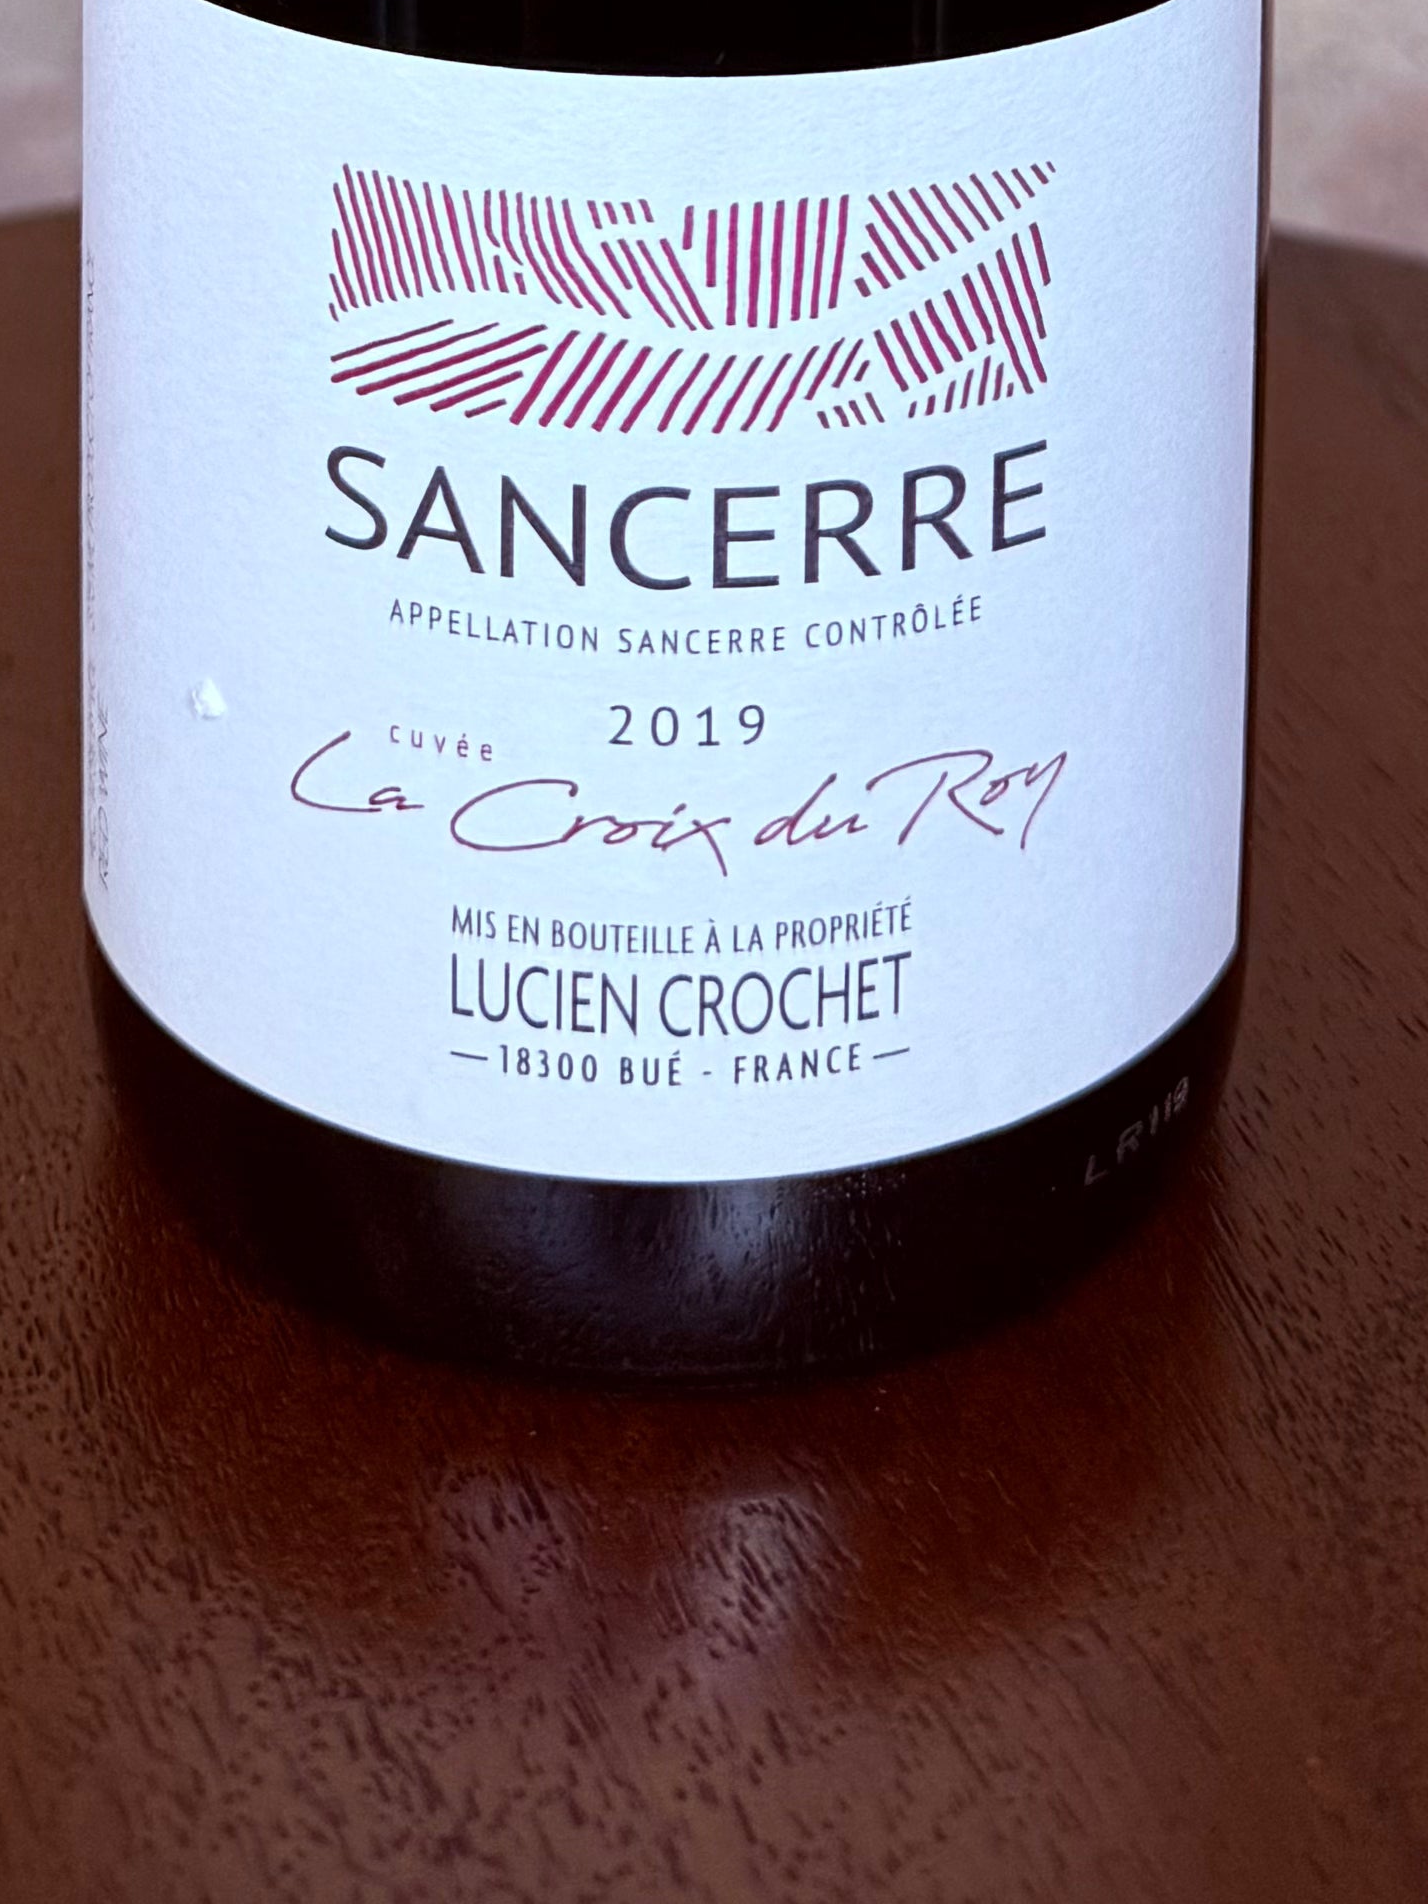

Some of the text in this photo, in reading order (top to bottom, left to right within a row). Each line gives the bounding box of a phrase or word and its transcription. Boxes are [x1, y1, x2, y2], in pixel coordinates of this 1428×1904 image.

[324, 438, 1048, 591] SANCERRE
[389, 593, 983, 655] APPELLATION SANCERRE CONTRÔLÉE
[389, 724, 493, 762] cuvée
[607, 704, 765, 748] 2019
[289, 730, 1068, 878] La Croix du Roy
[451, 895, 913, 955] MIS EN BOUTEILLE À LA PROPRIÉTÉ
[451, 950, 913, 1039] LUCIEN CROCHET
[499, 1043, 598, 1083] 18300
[619, 1049, 682, 1087] BUÉ
[733, 1042, 861, 1086] FRANCE
